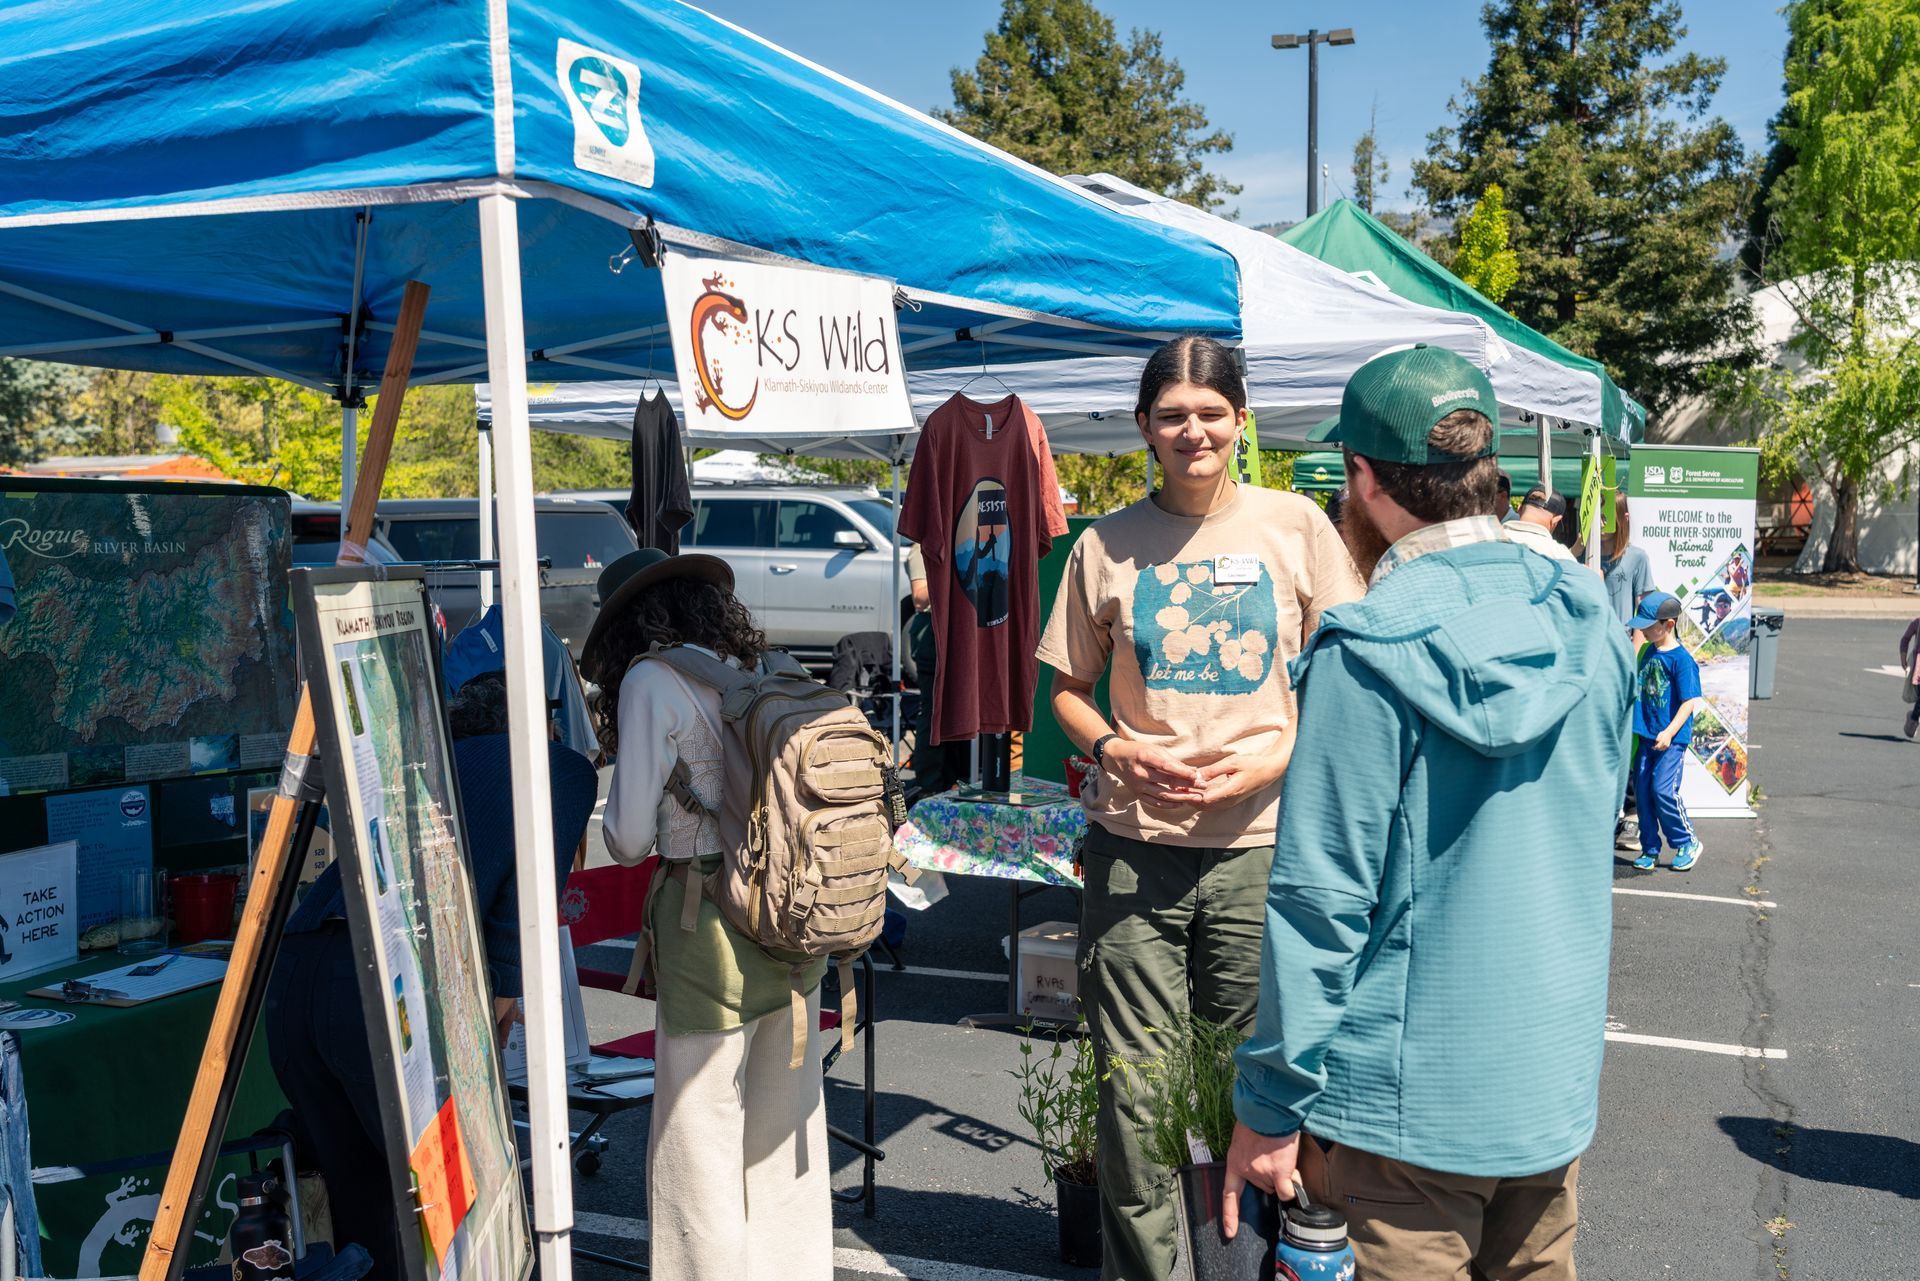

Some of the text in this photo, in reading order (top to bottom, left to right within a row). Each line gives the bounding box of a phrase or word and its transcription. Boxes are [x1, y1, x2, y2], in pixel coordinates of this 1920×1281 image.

[819, 310, 889, 375] Wild
[764, 378, 889, 396] Klamath-Siskiyou Wildlands Center
[1431, 388, 1480, 408] Biodiversity
[1644, 466, 1665, 476] USDA
[1685, 469, 1721, 478] Forest Service
[1658, 510, 1732, 524] WELCOME to the
[0, 518, 187, 559] Rogue RIVER BASIN
[1642, 526, 1742, 539] ROGUE RIVER-SISKIYOU
[1668, 539, 1714, 553] National
[1674, 554, 1707, 568] Forest
[1147, 662, 1220, 682] let me be
[314, 848, 326, 857] $20
[314, 861, 326, 869] $20
[23, 886, 57, 906] TAKE
[15, 903, 65, 927] ACTION
[21, 923, 59, 944] HERE
